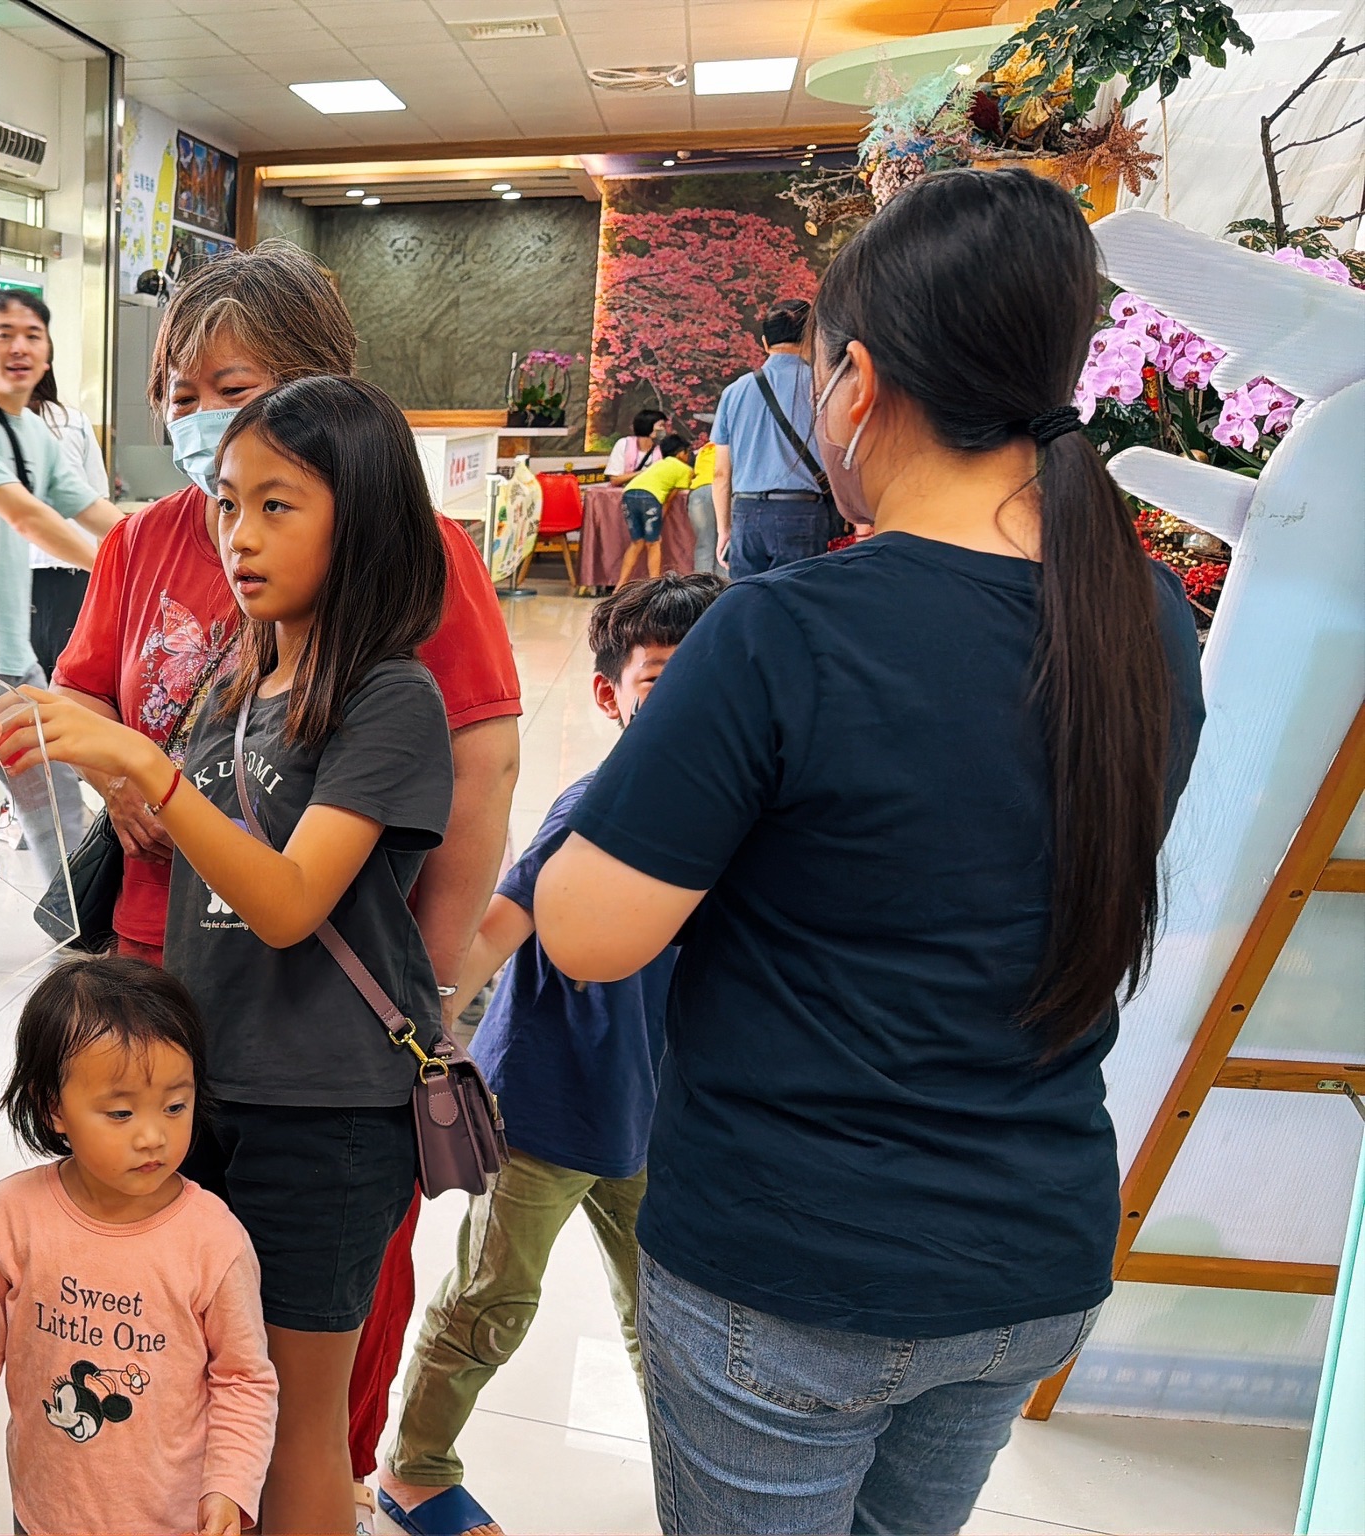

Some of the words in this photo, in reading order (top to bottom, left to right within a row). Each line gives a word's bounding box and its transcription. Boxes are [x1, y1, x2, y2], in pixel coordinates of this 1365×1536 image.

[192, 750, 284, 796] KUOMI
[60, 1276, 143, 1318] Sweet
[35, 1302, 103, 1347] Little
[113, 1321, 166, 1353] One
